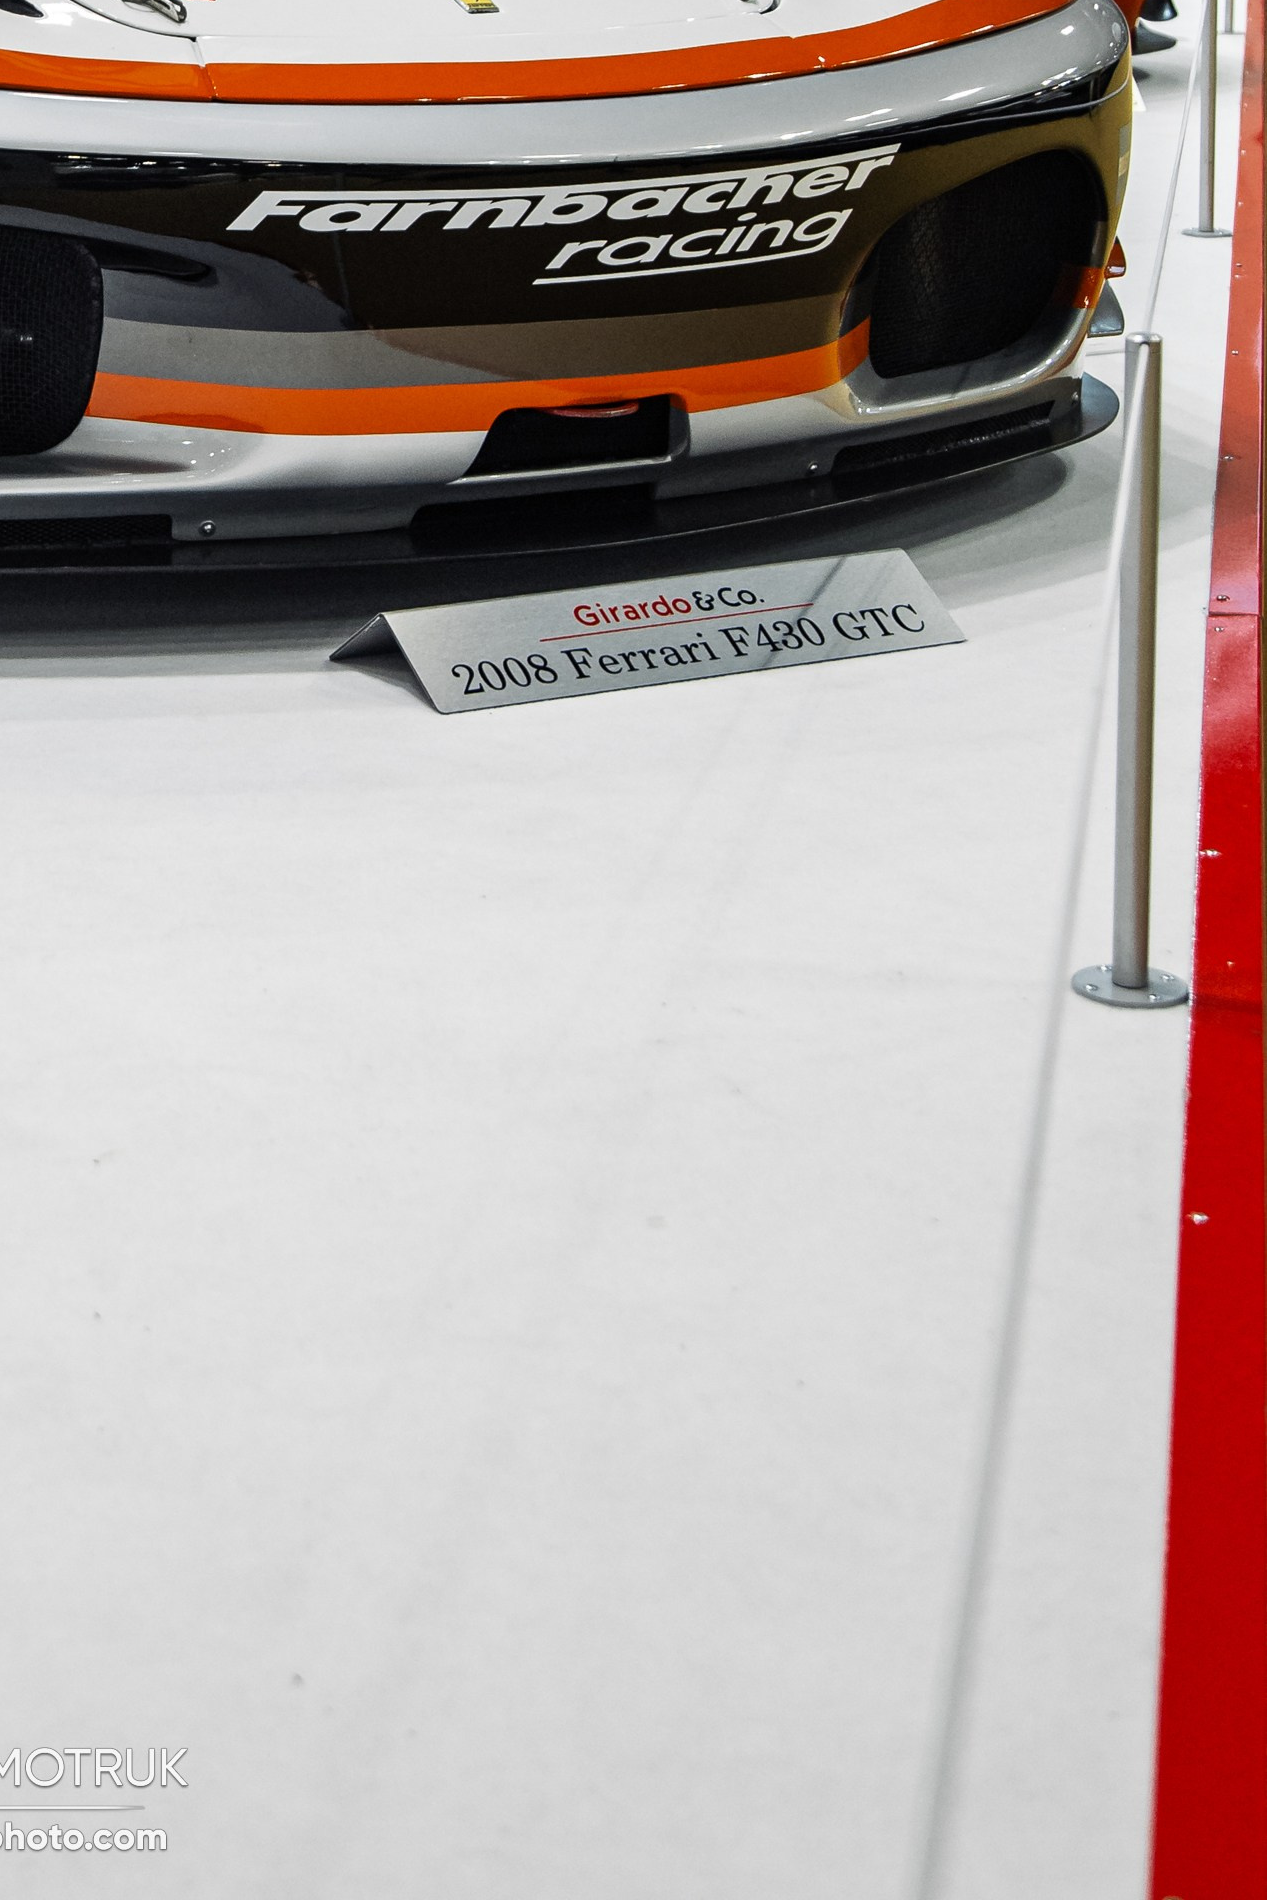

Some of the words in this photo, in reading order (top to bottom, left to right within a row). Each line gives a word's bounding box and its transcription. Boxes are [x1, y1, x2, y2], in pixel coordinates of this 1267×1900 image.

[227, 143, 901, 231] Farnbacher
[532, 208, 853, 285] racing
[451, 652, 558, 696] 2008
[561, 632, 719, 680] Ferrari
[718, 616, 825, 658] F430
[831, 603, 926, 642] GTC
